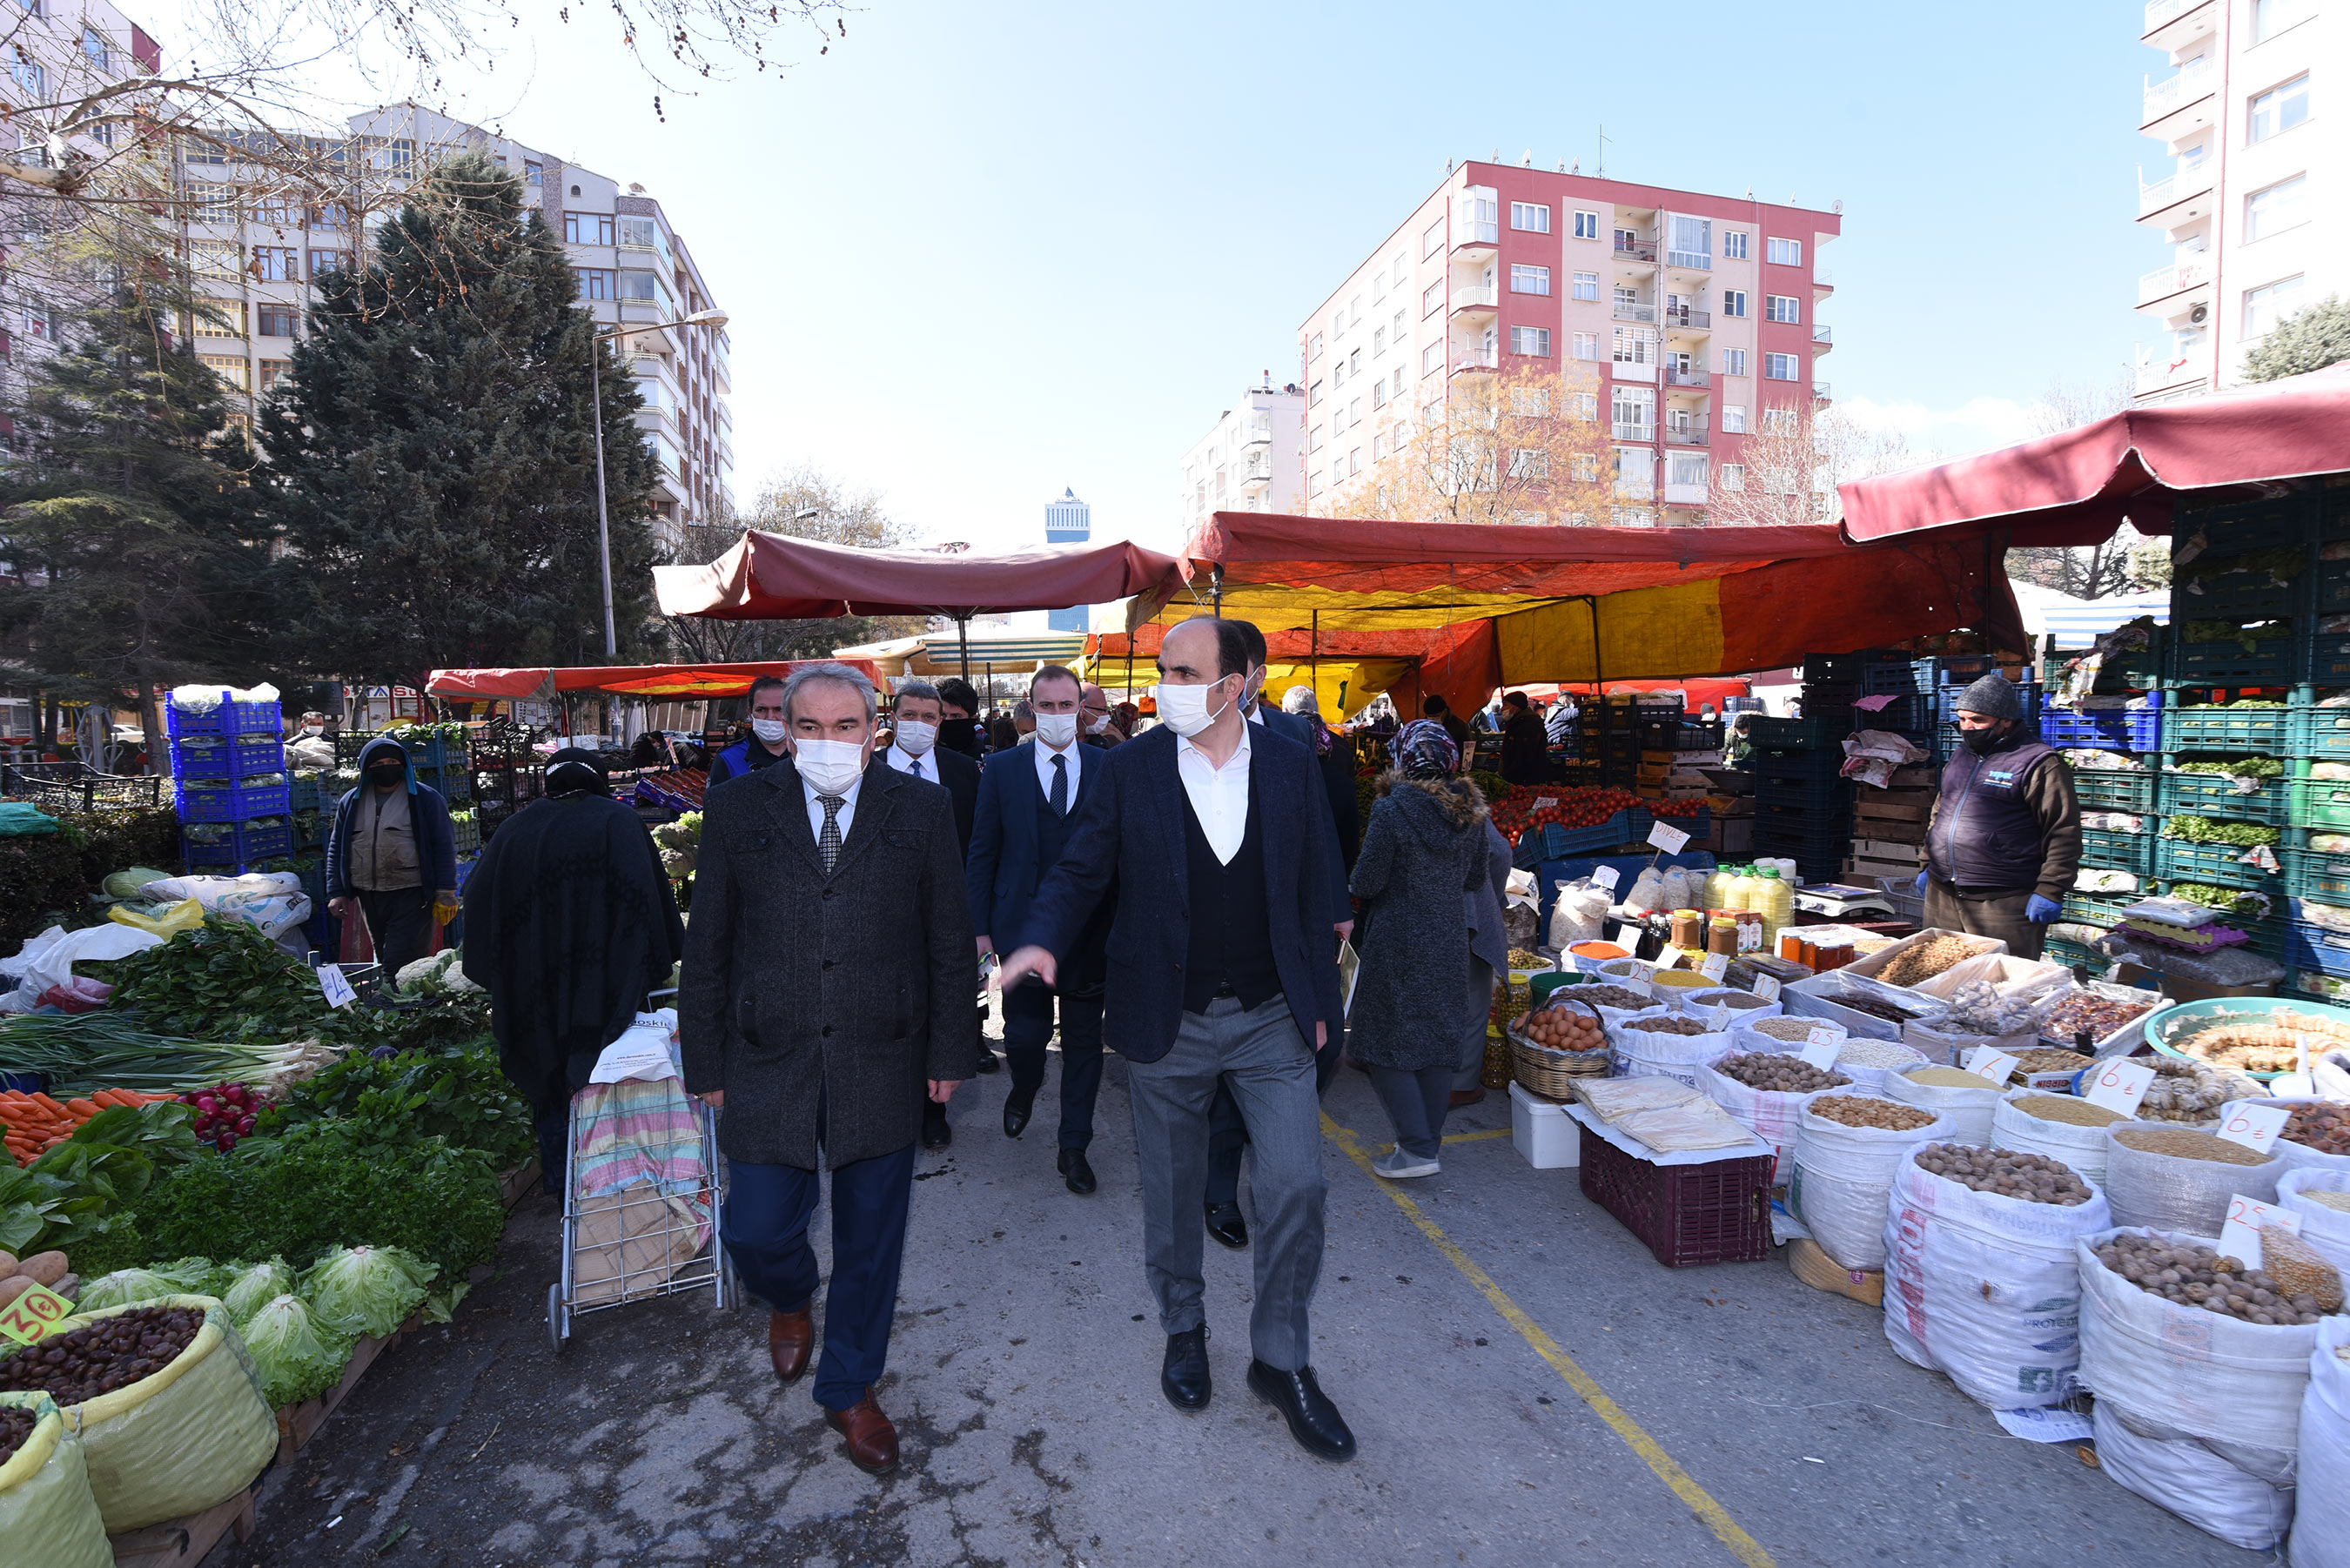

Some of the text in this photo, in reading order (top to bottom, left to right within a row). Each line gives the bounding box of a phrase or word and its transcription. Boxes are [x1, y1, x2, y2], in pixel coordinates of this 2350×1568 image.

[1631, 962, 1652, 983] 25
[1705, 953, 1726, 972] 12
[1755, 977, 1777, 1001] 12
[1810, 1030, 1835, 1047] 25
[1979, 1057, 2002, 1080] 6
[2101, 1062, 2122, 1087] 6
[2227, 1106, 2251, 1132] 6
[1, 1293, 63, 1342] 30
